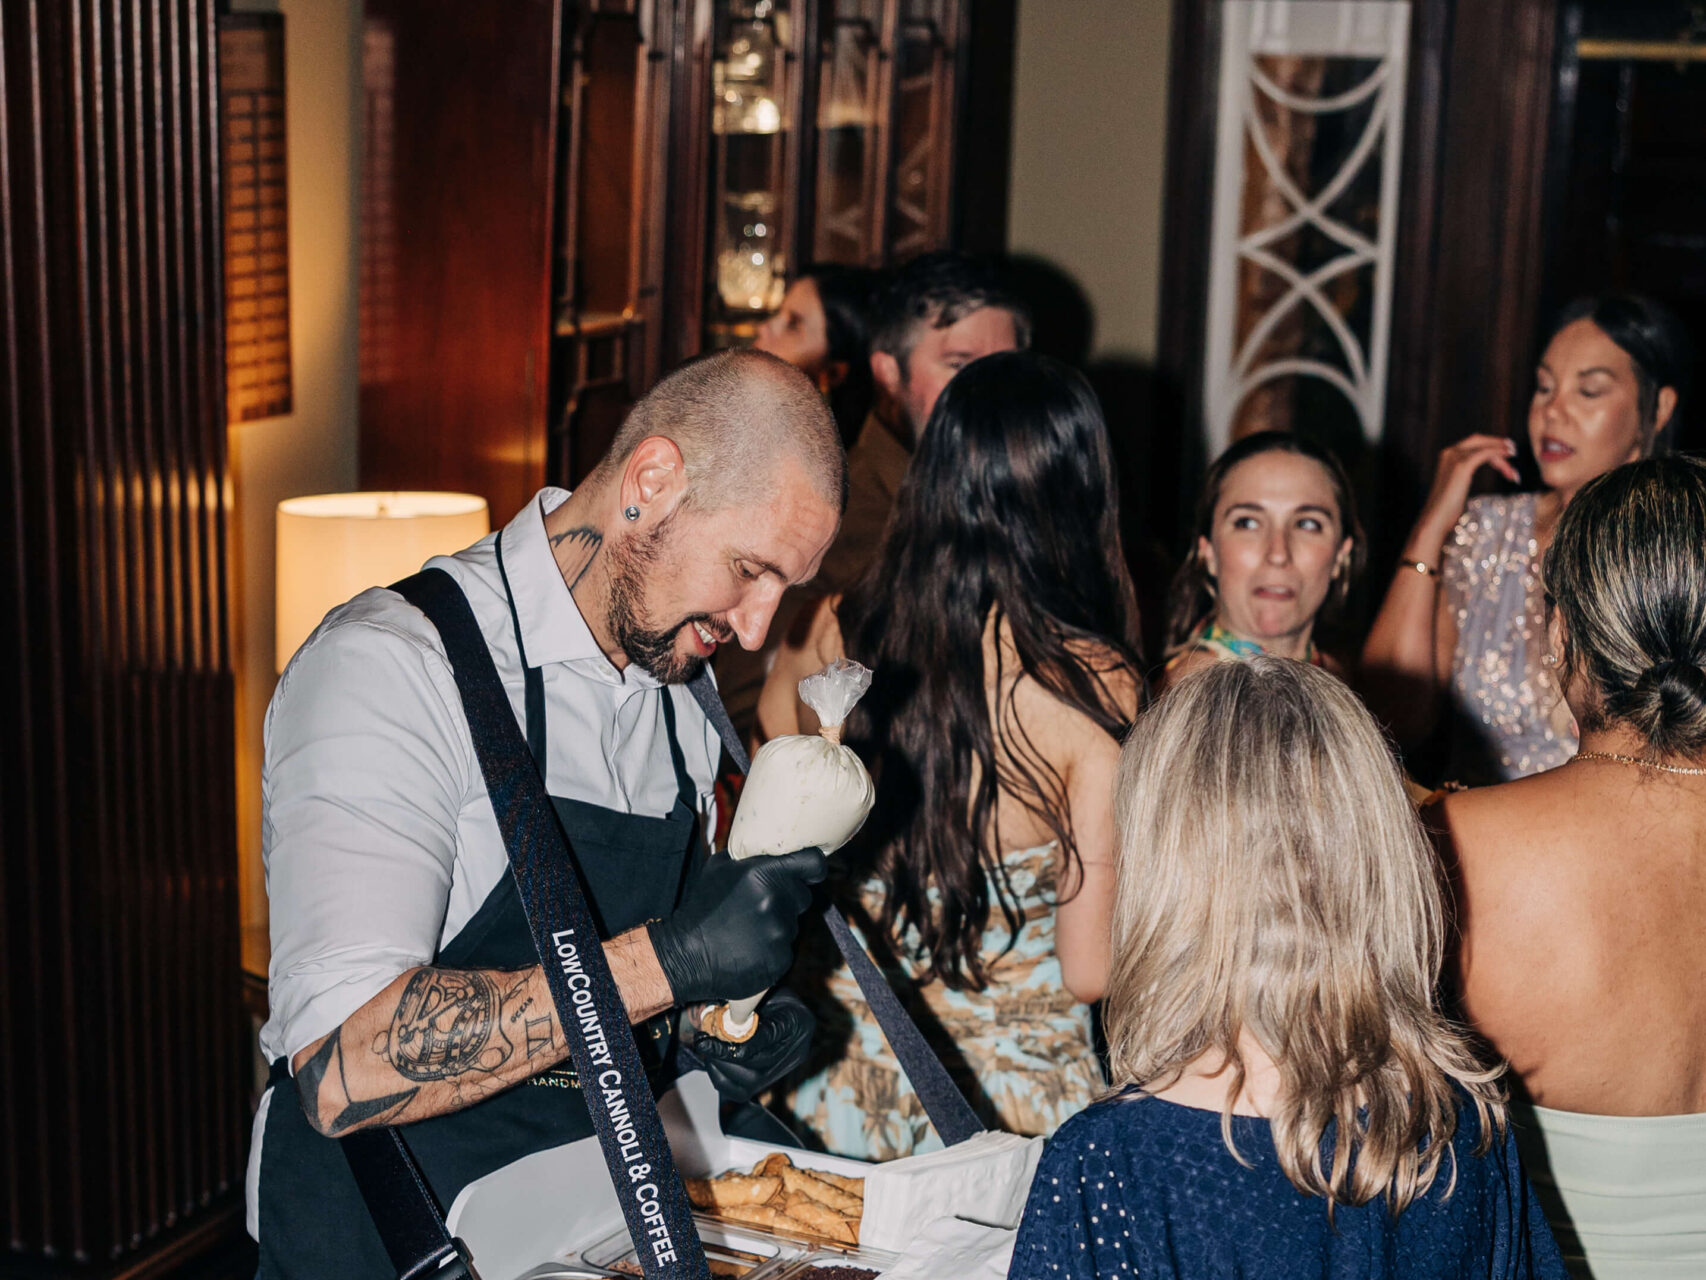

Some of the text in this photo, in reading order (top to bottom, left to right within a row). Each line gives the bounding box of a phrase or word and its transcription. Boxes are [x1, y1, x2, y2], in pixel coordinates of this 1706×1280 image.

[599, 1070, 642, 1162] CANNOLI
[628, 1163, 651, 1182] &
[635, 1183, 677, 1267] COFFEE
